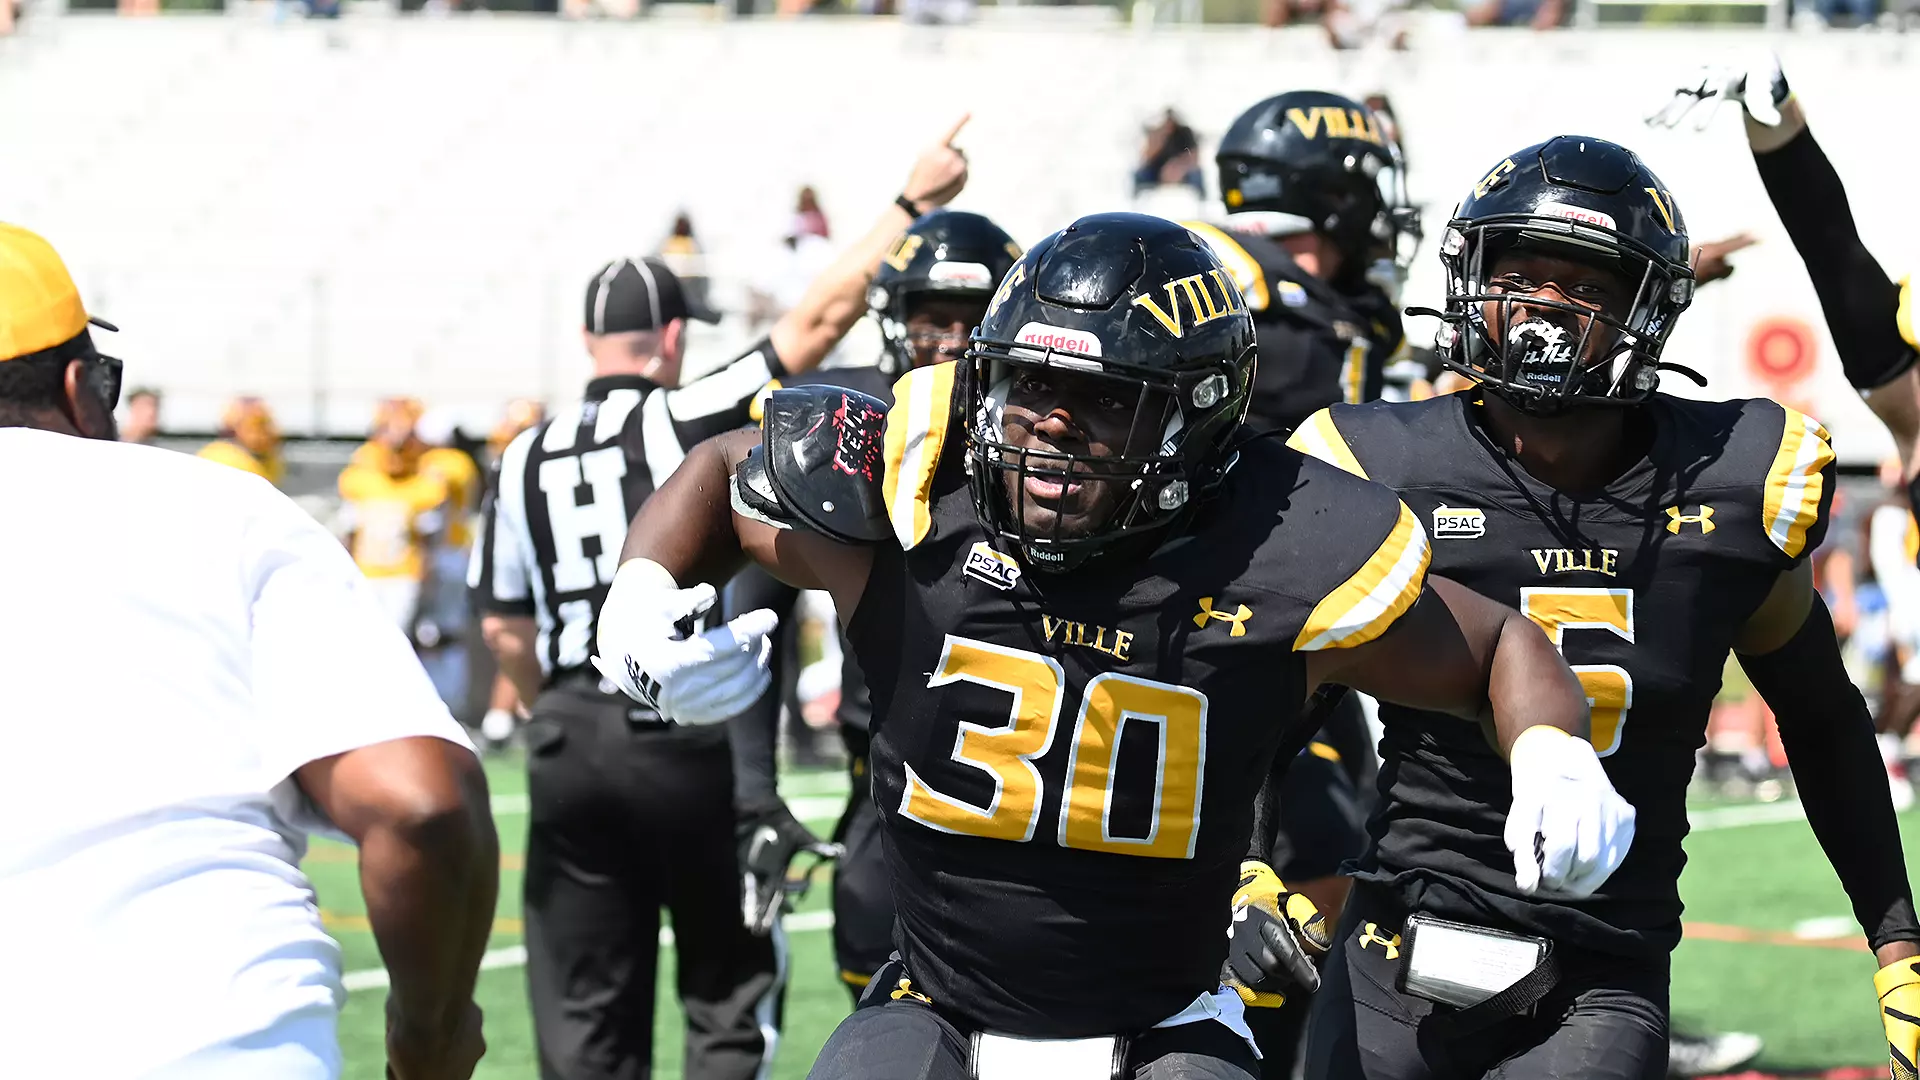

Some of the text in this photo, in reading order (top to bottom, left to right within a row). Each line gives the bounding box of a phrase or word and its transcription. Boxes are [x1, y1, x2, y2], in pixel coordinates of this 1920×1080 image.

[1131, 266, 1241, 339] VILL
[1525, 371, 1562, 384] Riddell
[539, 444, 629, 594] H
[1436, 515, 1481, 530] PSAC
[969, 551, 1018, 583] PSAC
[1030, 546, 1065, 562] Riddell
[1530, 548, 1620, 578] VILLE
[1040, 612, 1134, 662] VILLE
[897, 632, 1209, 860] 30
